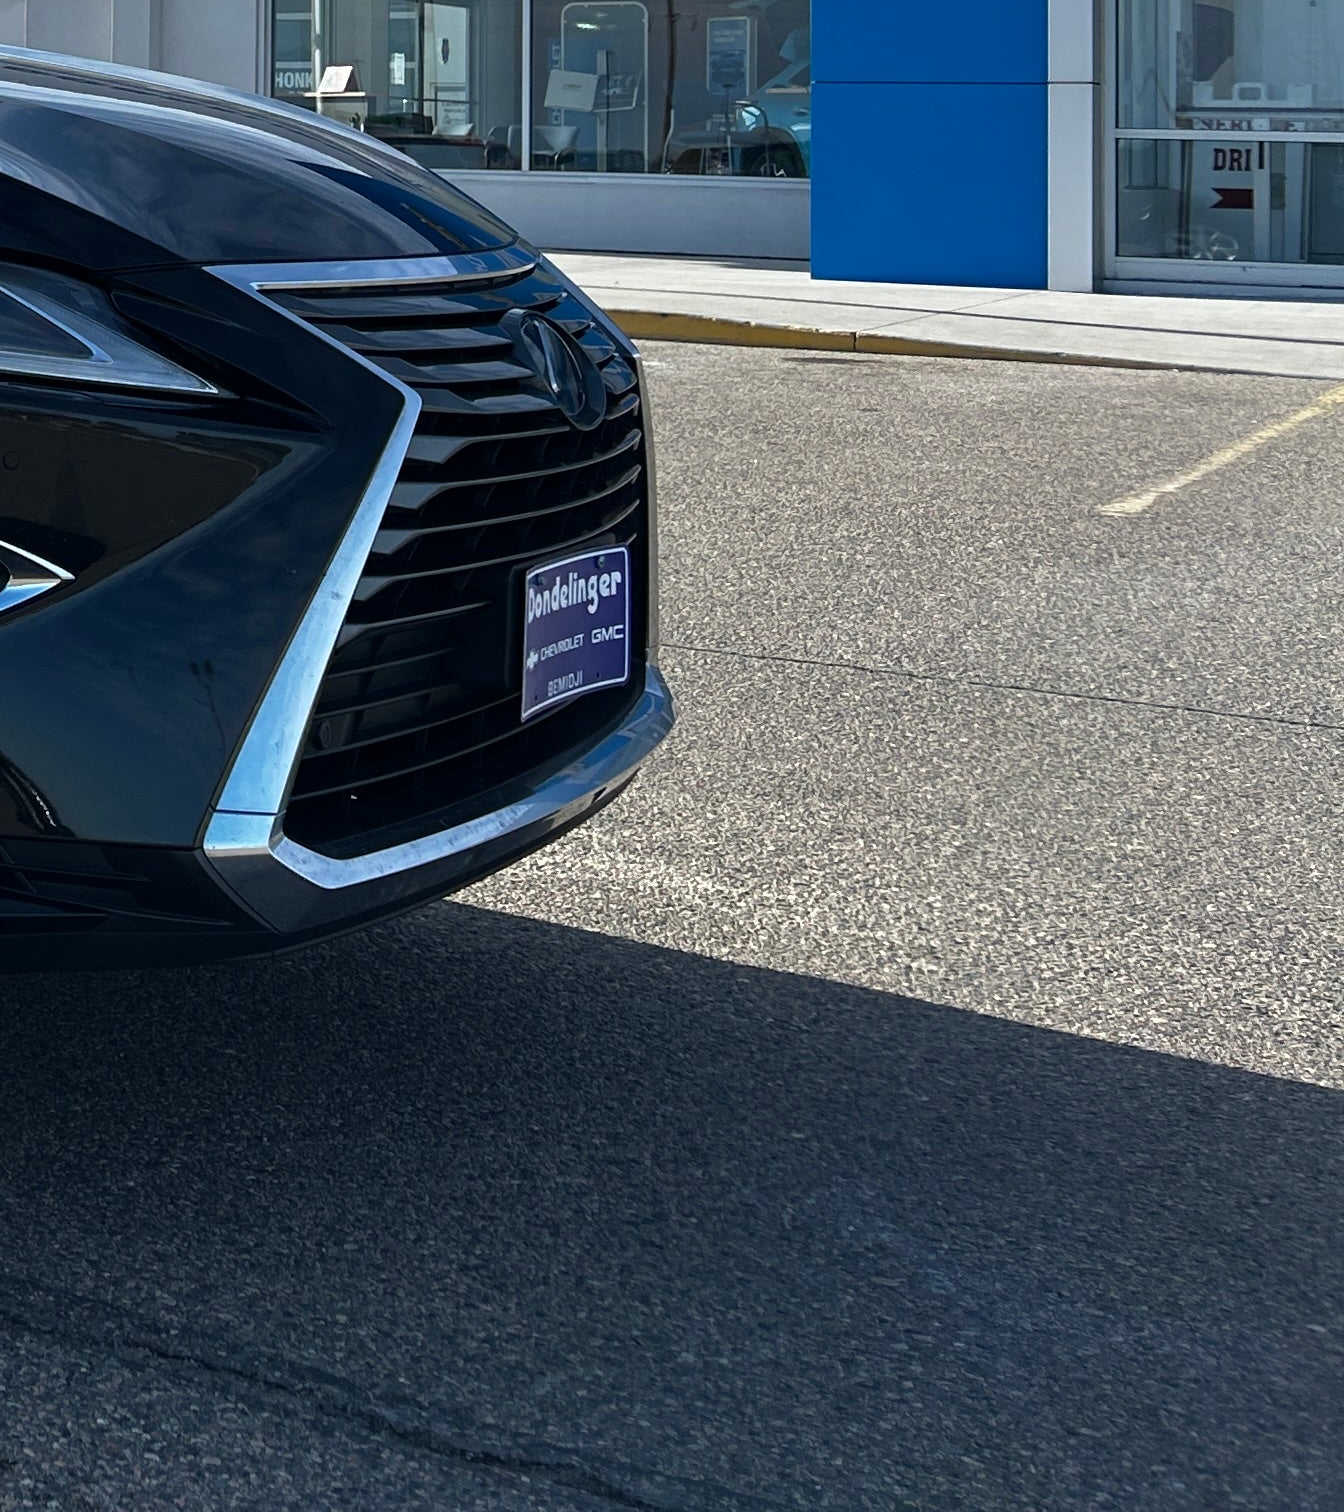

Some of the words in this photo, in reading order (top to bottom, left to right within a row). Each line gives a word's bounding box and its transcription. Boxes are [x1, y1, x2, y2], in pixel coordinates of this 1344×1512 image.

[1213, 148, 1252, 171] DRI
[528, 571, 622, 623] Dondelinger
[540, 633, 585, 661] CHEVROLET
[591, 624, 624, 644] GMC
[547, 670, 583, 697] BEMIDJI
